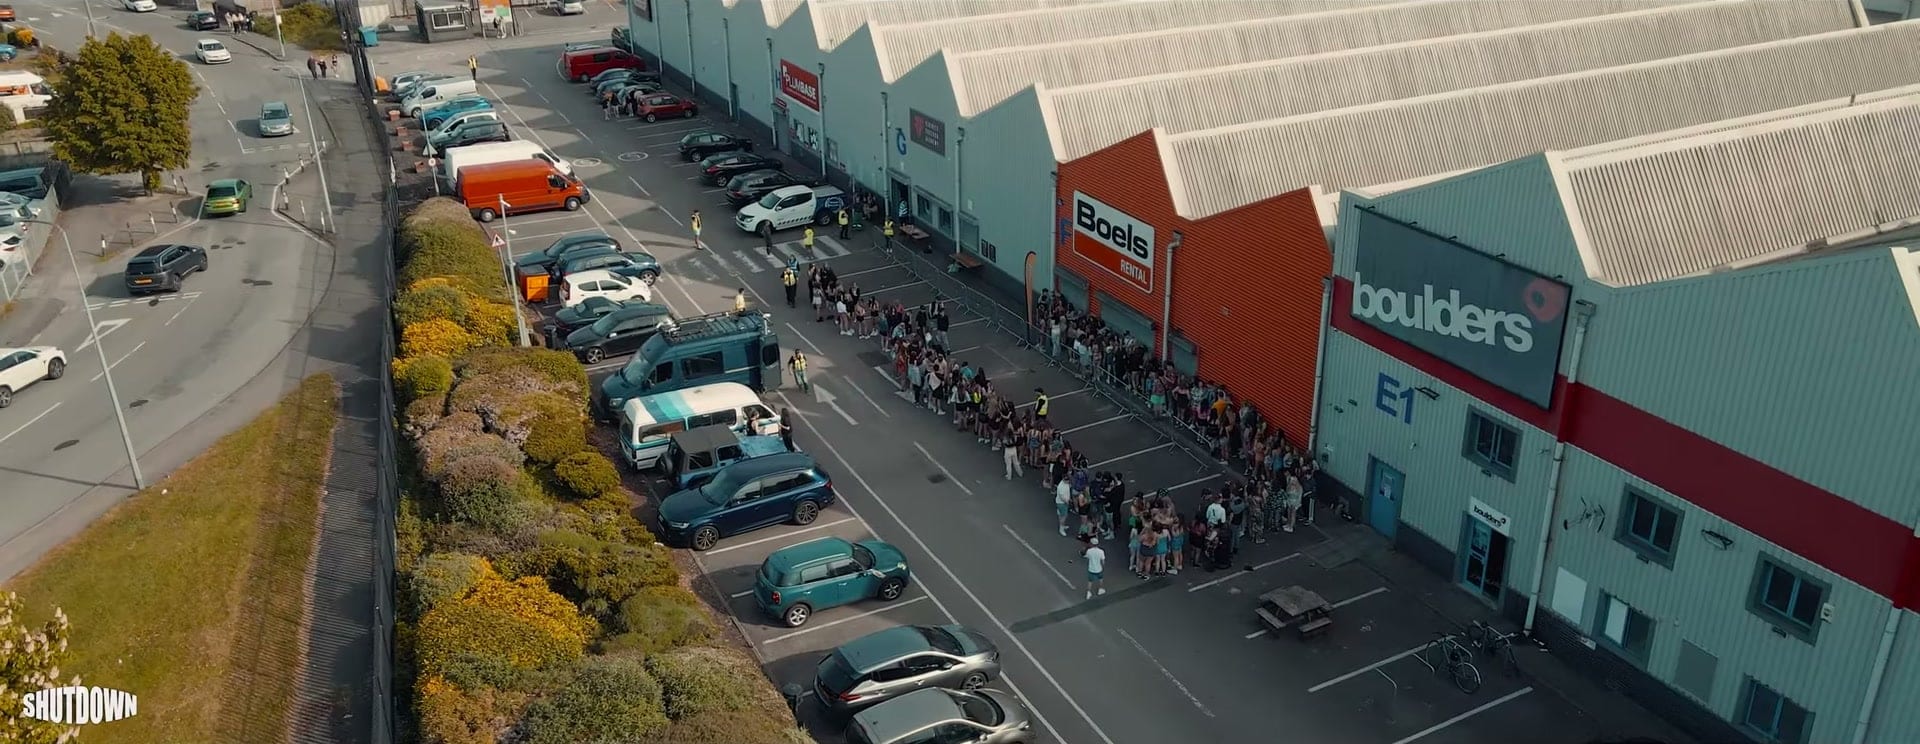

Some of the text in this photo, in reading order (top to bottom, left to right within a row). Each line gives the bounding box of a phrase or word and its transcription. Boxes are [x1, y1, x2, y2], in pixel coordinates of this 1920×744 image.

[785, 72, 817, 100] PLUMBASE
[895, 127, 907, 156] G
[1077, 199, 1149, 260] Boels
[1120, 259, 1148, 285] RENTAL
[1352, 271, 1533, 353] boulders
[1376, 372, 1415, 425] E1
